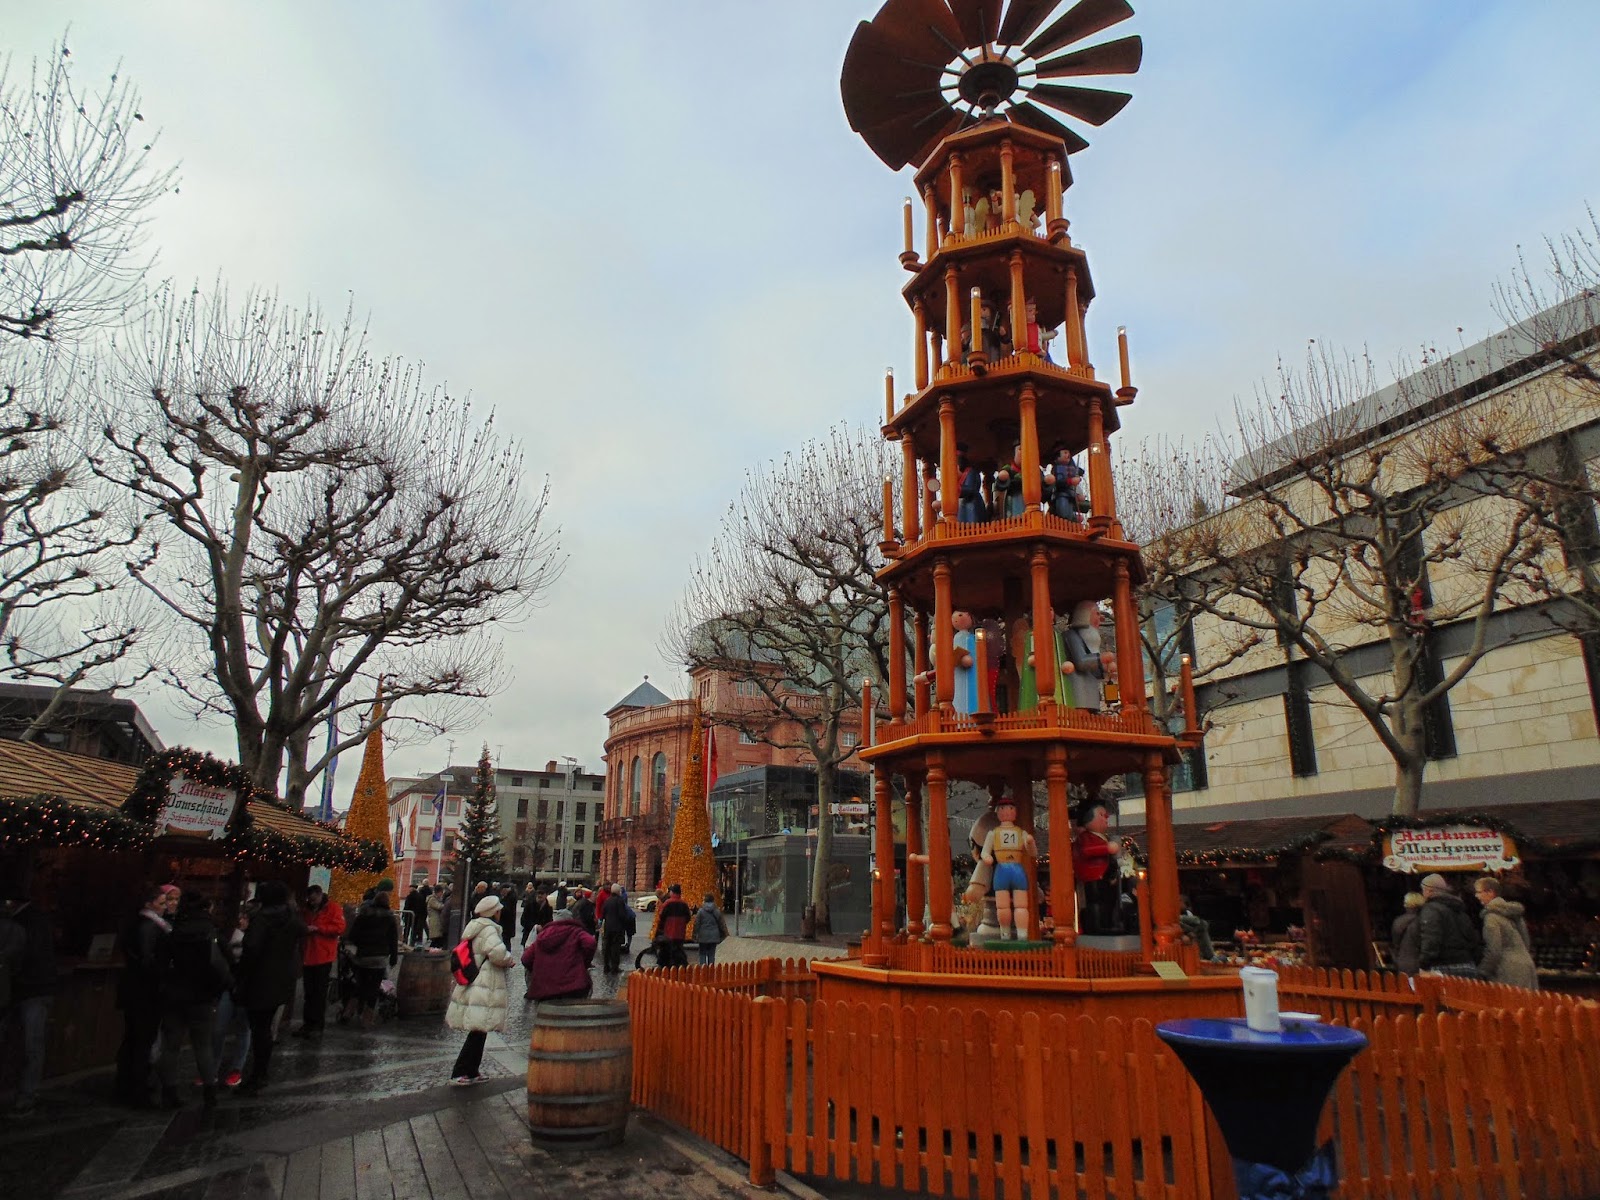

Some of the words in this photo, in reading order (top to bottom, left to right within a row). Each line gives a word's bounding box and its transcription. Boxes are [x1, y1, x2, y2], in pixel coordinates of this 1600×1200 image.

[178, 783, 226, 800] Mainzer
[166, 793, 228, 816] Domschänke
[1003, 832, 1016, 844] 21
[1396, 829, 1498, 845] Holzkunst
[1396, 841, 1502, 856] Machemer
[1388, 857, 1395, 867] 2
